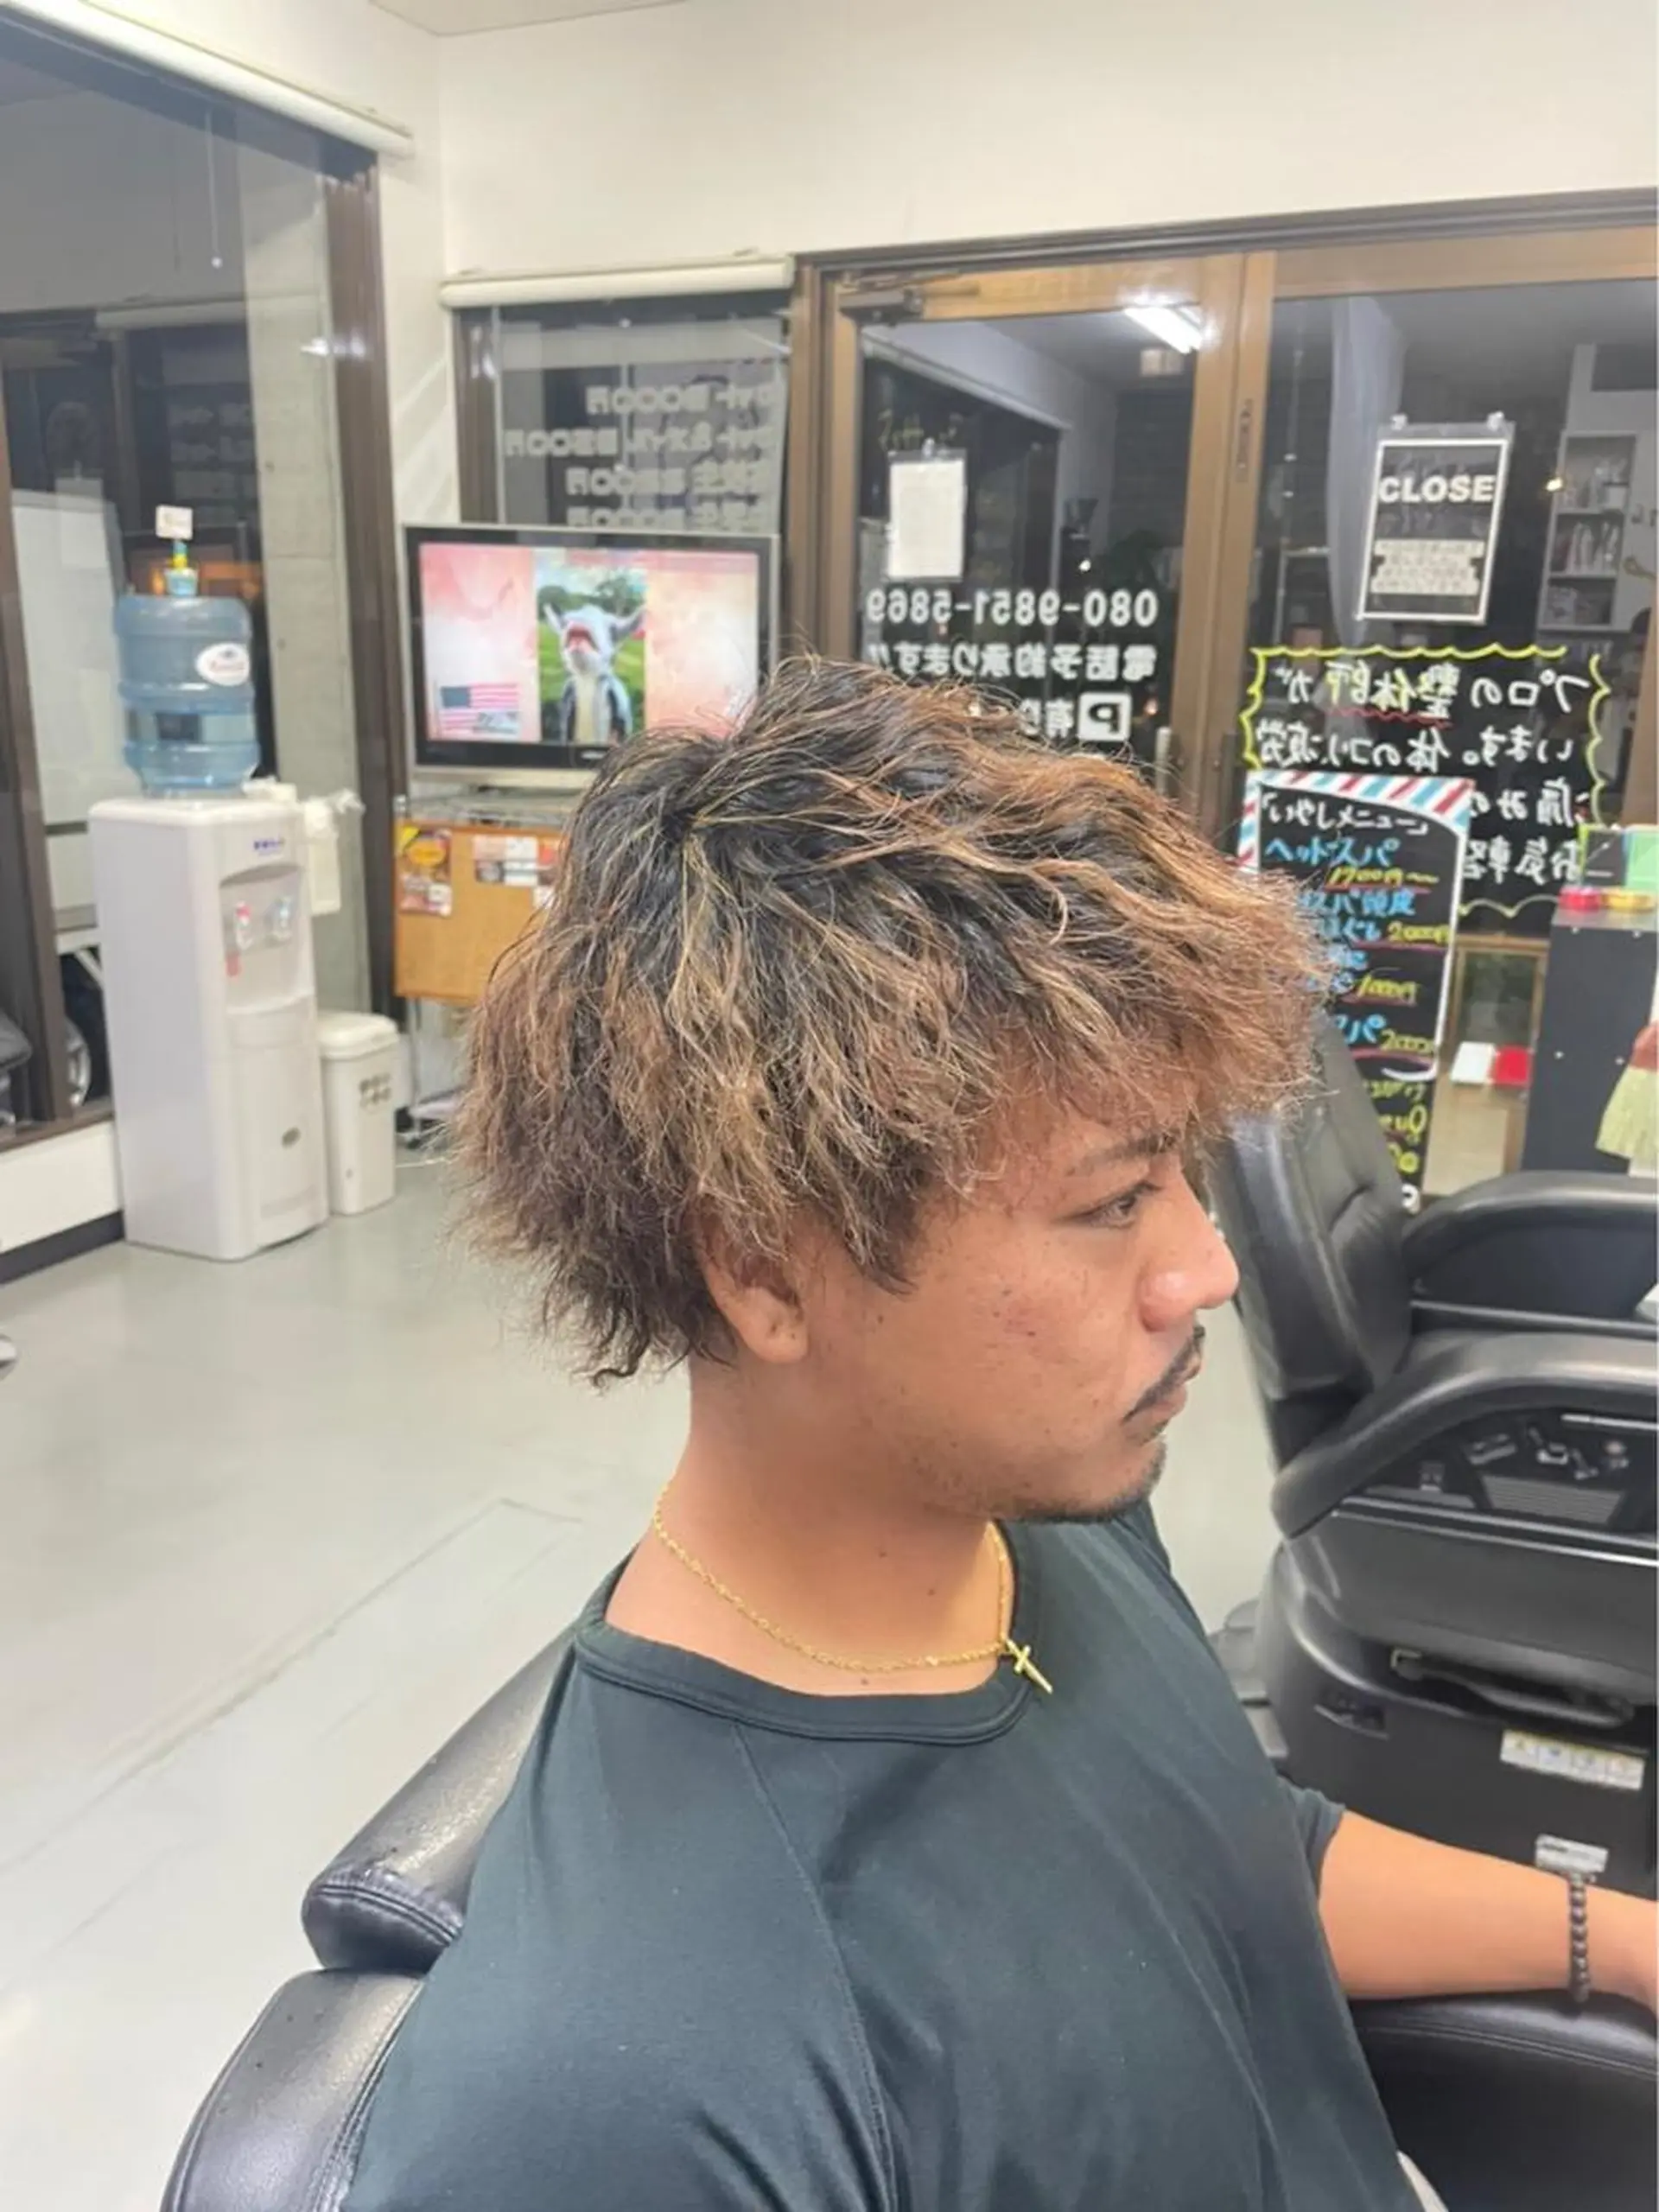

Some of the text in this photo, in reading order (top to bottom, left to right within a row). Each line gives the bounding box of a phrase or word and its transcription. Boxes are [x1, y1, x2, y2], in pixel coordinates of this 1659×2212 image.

[1378, 474, 1497, 503] CLOSE
[1265, 836, 1401, 867] ヘッドスパ
